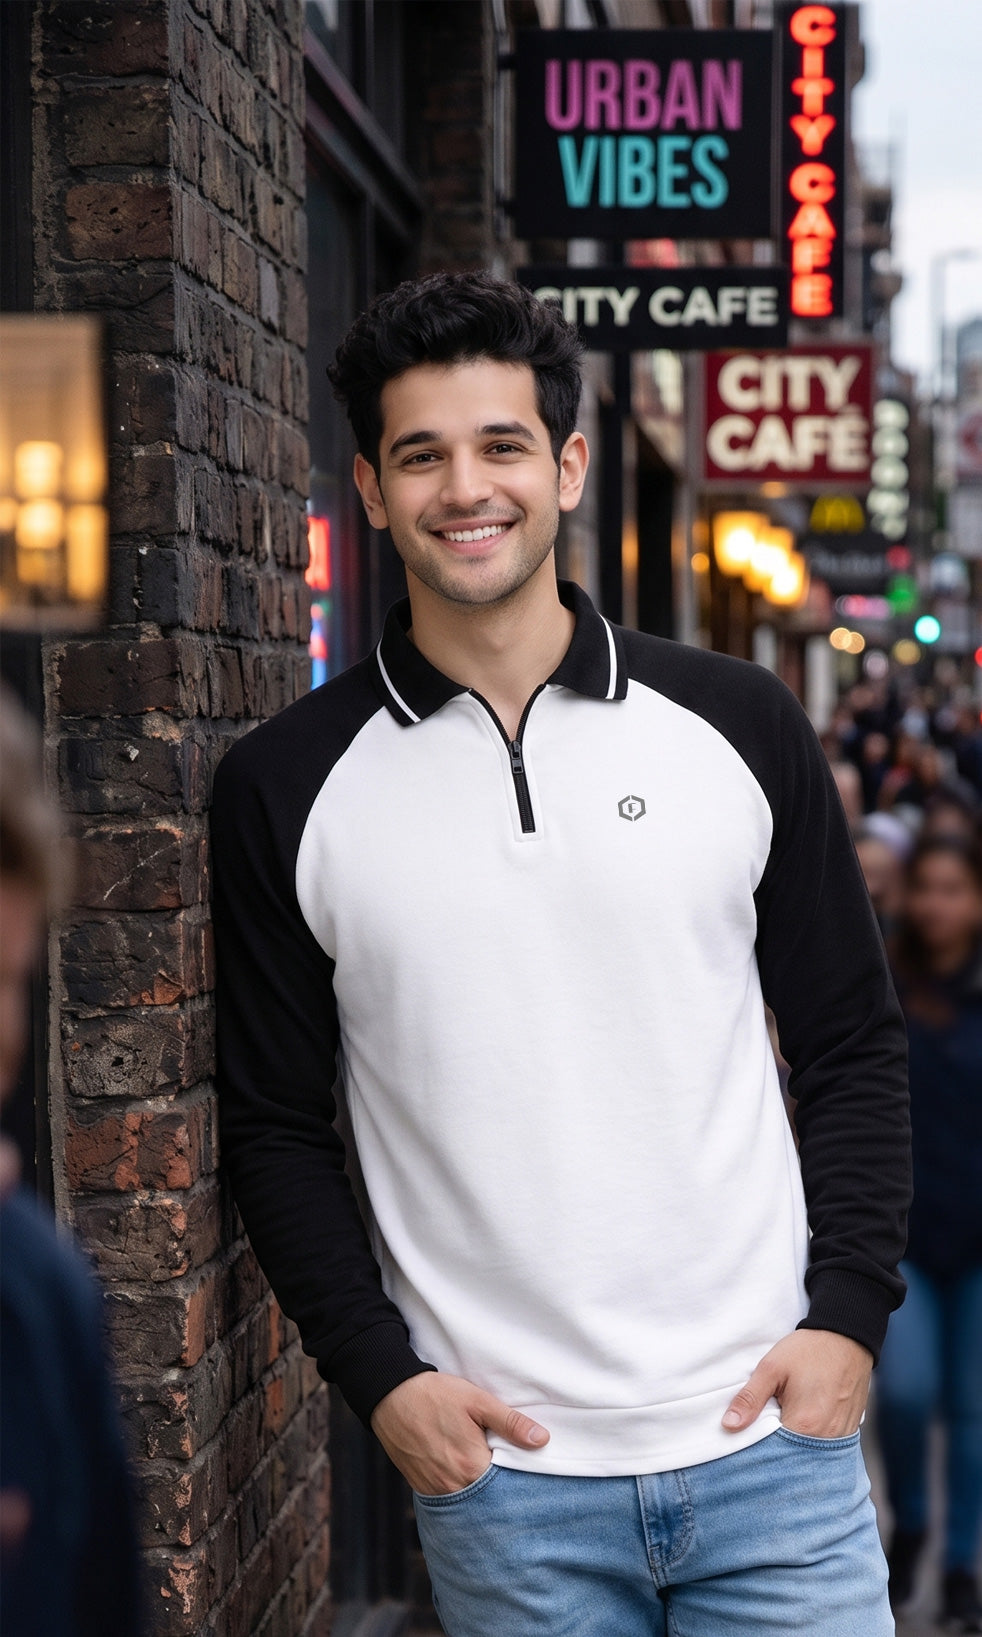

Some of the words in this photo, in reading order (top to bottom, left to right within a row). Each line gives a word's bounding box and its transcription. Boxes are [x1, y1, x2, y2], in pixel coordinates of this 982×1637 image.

[545, 59, 742, 131] URBAN
[789, 5, 836, 156] CITY
[558, 135, 729, 208] VIBES
[788, 162, 836, 316] CAFE
[648, 286, 779, 326] CAFE
[717, 355, 862, 412] CITY
[707, 404, 870, 472] CAFÉ
